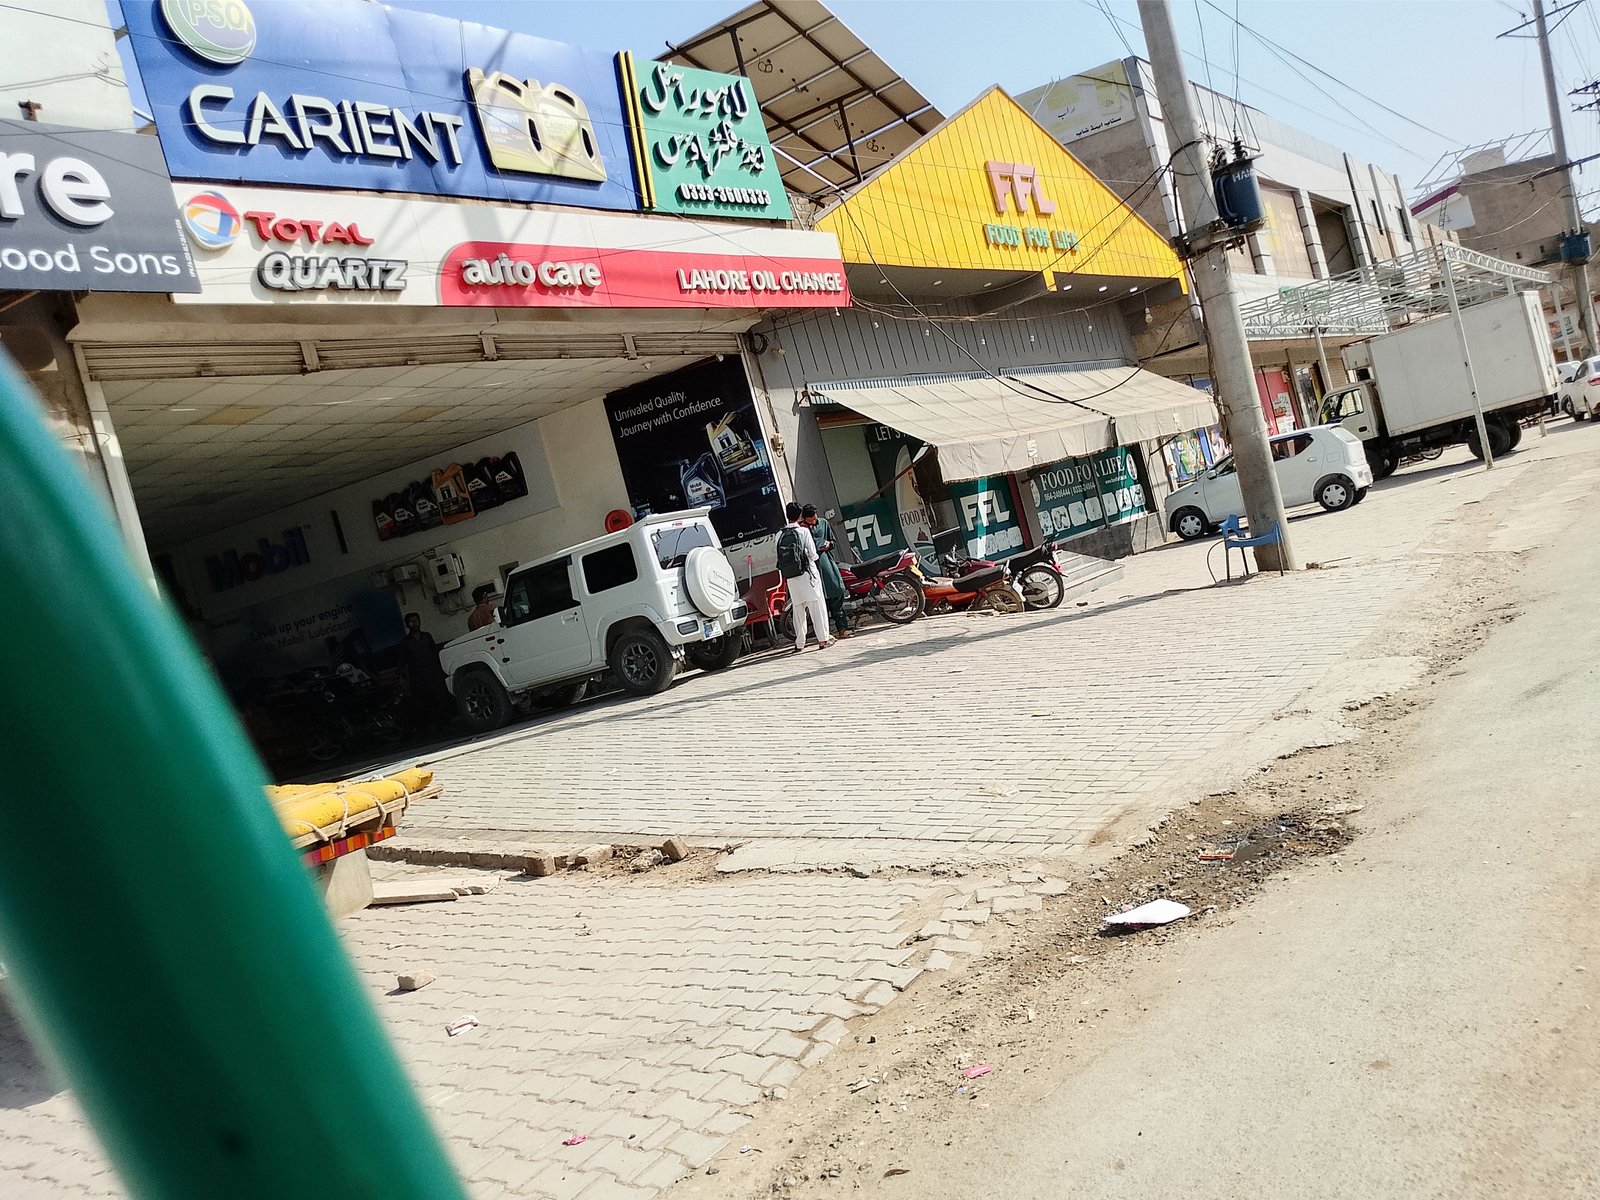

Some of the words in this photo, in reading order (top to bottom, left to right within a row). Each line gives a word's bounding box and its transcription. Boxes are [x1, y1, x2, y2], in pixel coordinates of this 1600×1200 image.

[689, 79, 749, 119] لاہور
[189, 84, 464, 164] CARIENT
[985, 161, 1056, 215] FFL
[244, 211, 376, 246] TOTAL
[985, 224, 1022, 249] FOOD
[1023, 226, 1051, 249] FOR
[1052, 229, 1080, 253] LIFE
[0, 243, 81, 272] ood
[90, 245, 181, 275] Sons
[258, 251, 408, 292] QUARTZ
[462, 253, 536, 288] auto
[537, 260, 602, 289] care
[677, 267, 750, 292] LAHORE
[751, 270, 781, 292] OIL
[780, 271, 845, 293] CHANGE
[614, 401, 654, 422] Unrivaled
[654, 391, 687, 410] Quality.
[619, 419, 652, 439] Journey
[653, 411, 673, 427] with
[672, 396, 724, 420] Confidence.
[1040, 467, 1074, 491] FOOD
[1099, 455, 1126, 477] LIFE
[900, 511, 921, 528] FOOD
[960, 489, 1010, 532] FFL
[205, 526, 310, 593] Mobil
